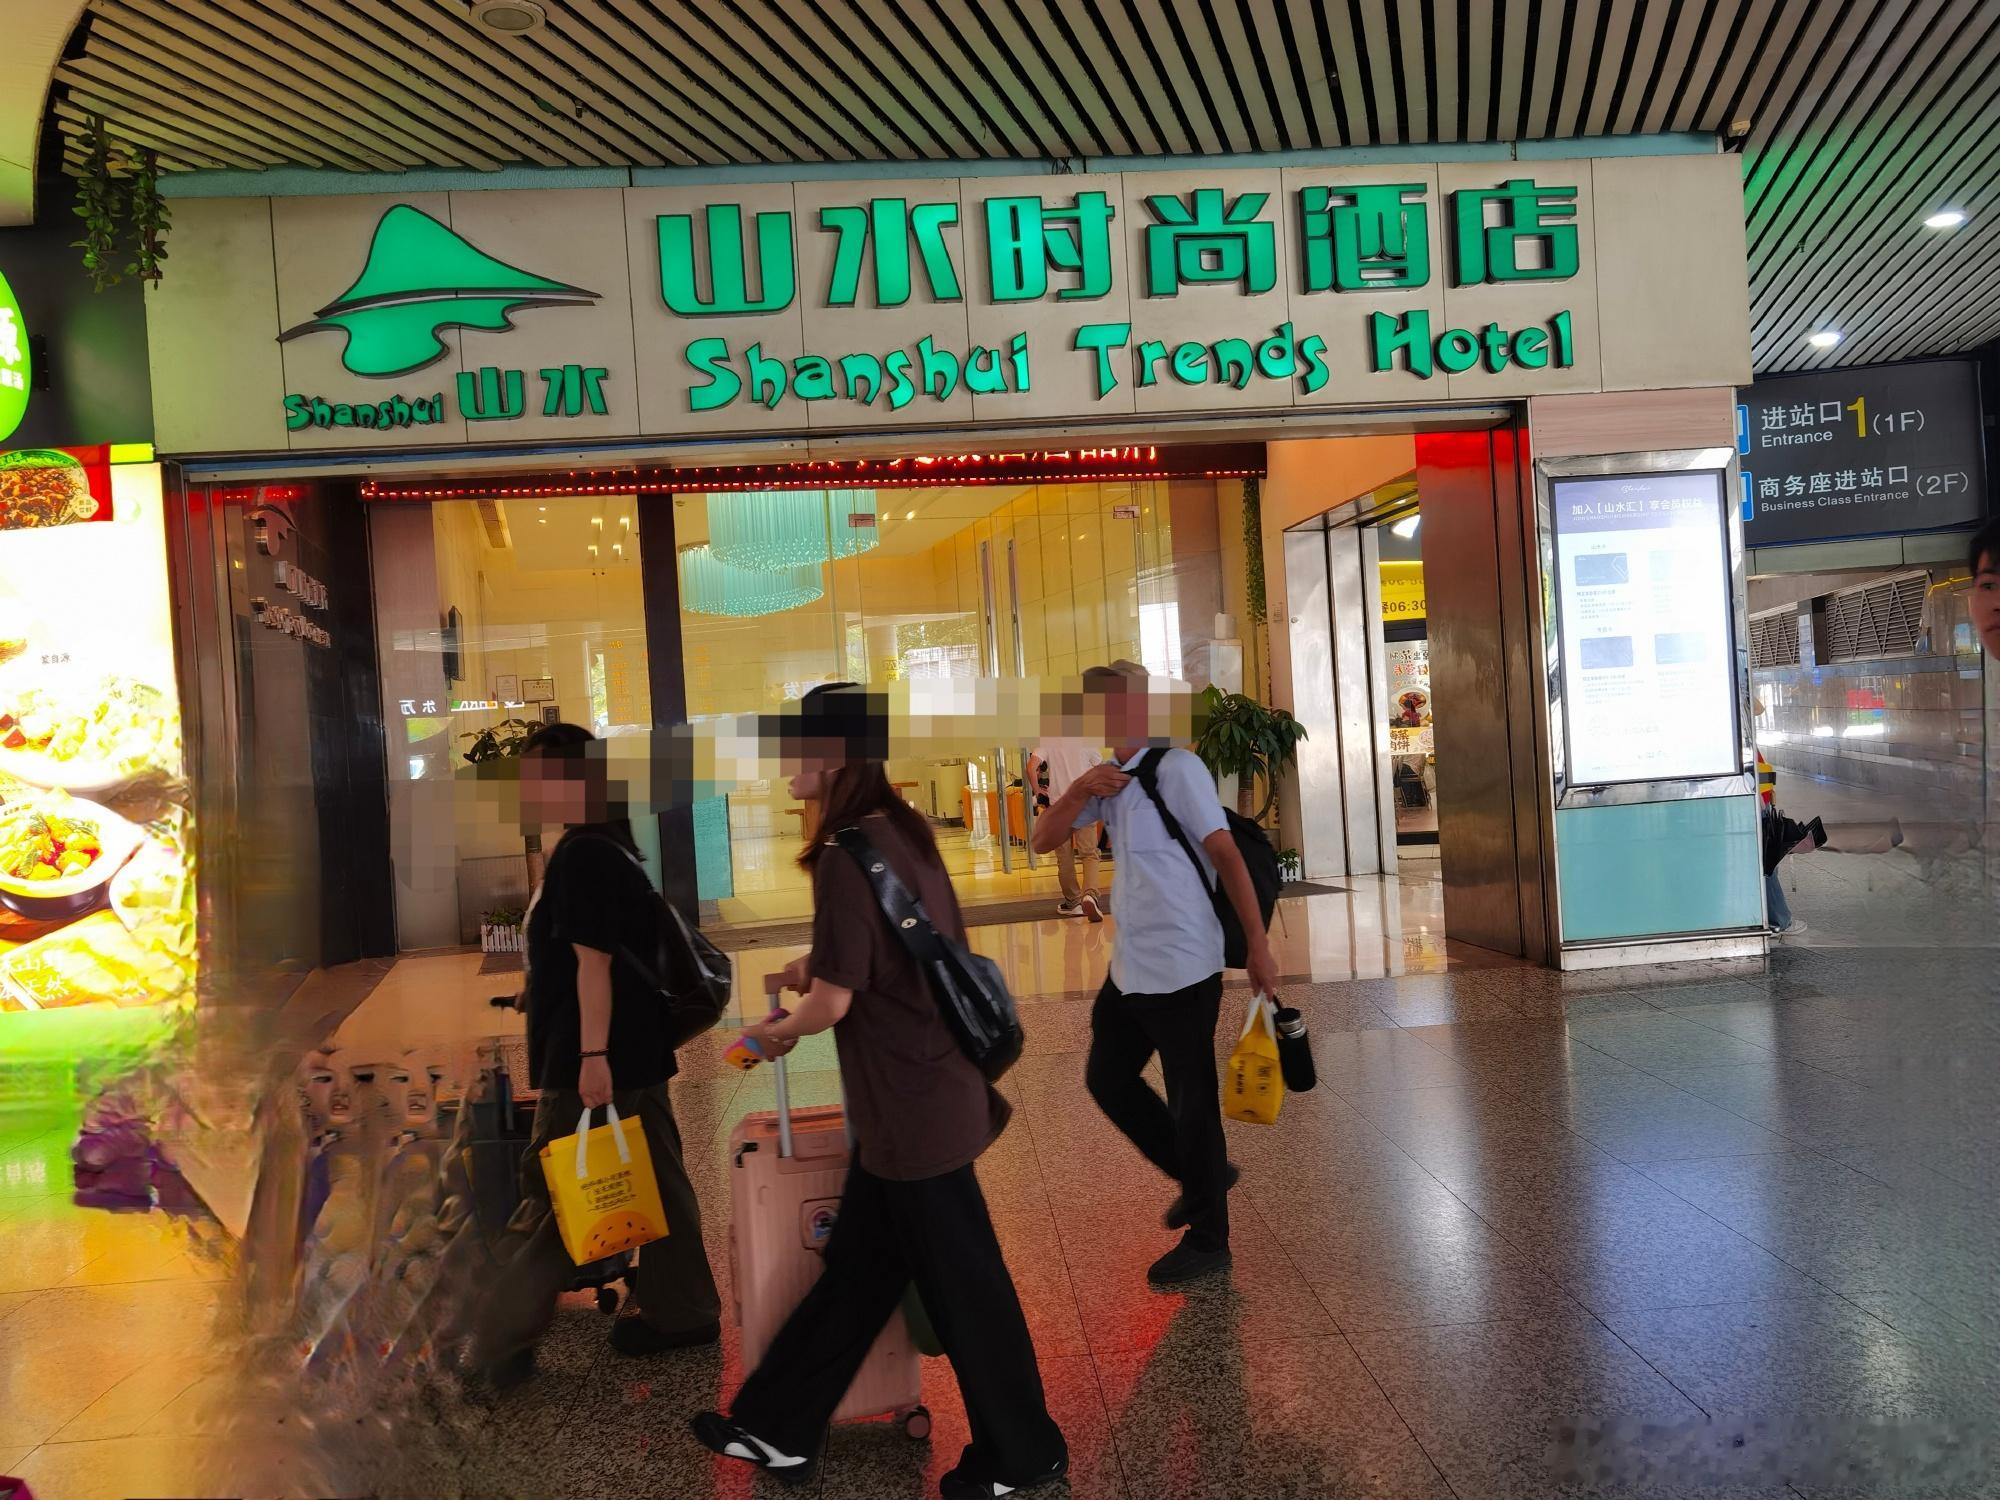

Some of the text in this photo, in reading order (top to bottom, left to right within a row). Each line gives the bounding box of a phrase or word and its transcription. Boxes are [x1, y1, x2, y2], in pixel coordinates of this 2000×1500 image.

[655, 178, 1580, 318] 山水时尚酒店
[685, 308, 1575, 412] Shanshui Trends Hotel
[282, 391, 446, 432] Shanshui
[455, 364, 610, 421] 山水
[1761, 396, 1925, 438] 进站口 1 (1F)
[1761, 429, 1833, 448] Entrance
[1758, 465, 1969, 499] 商务座进站口 (2F)
[1761, 490, 1909, 512] Business Class Entrance
